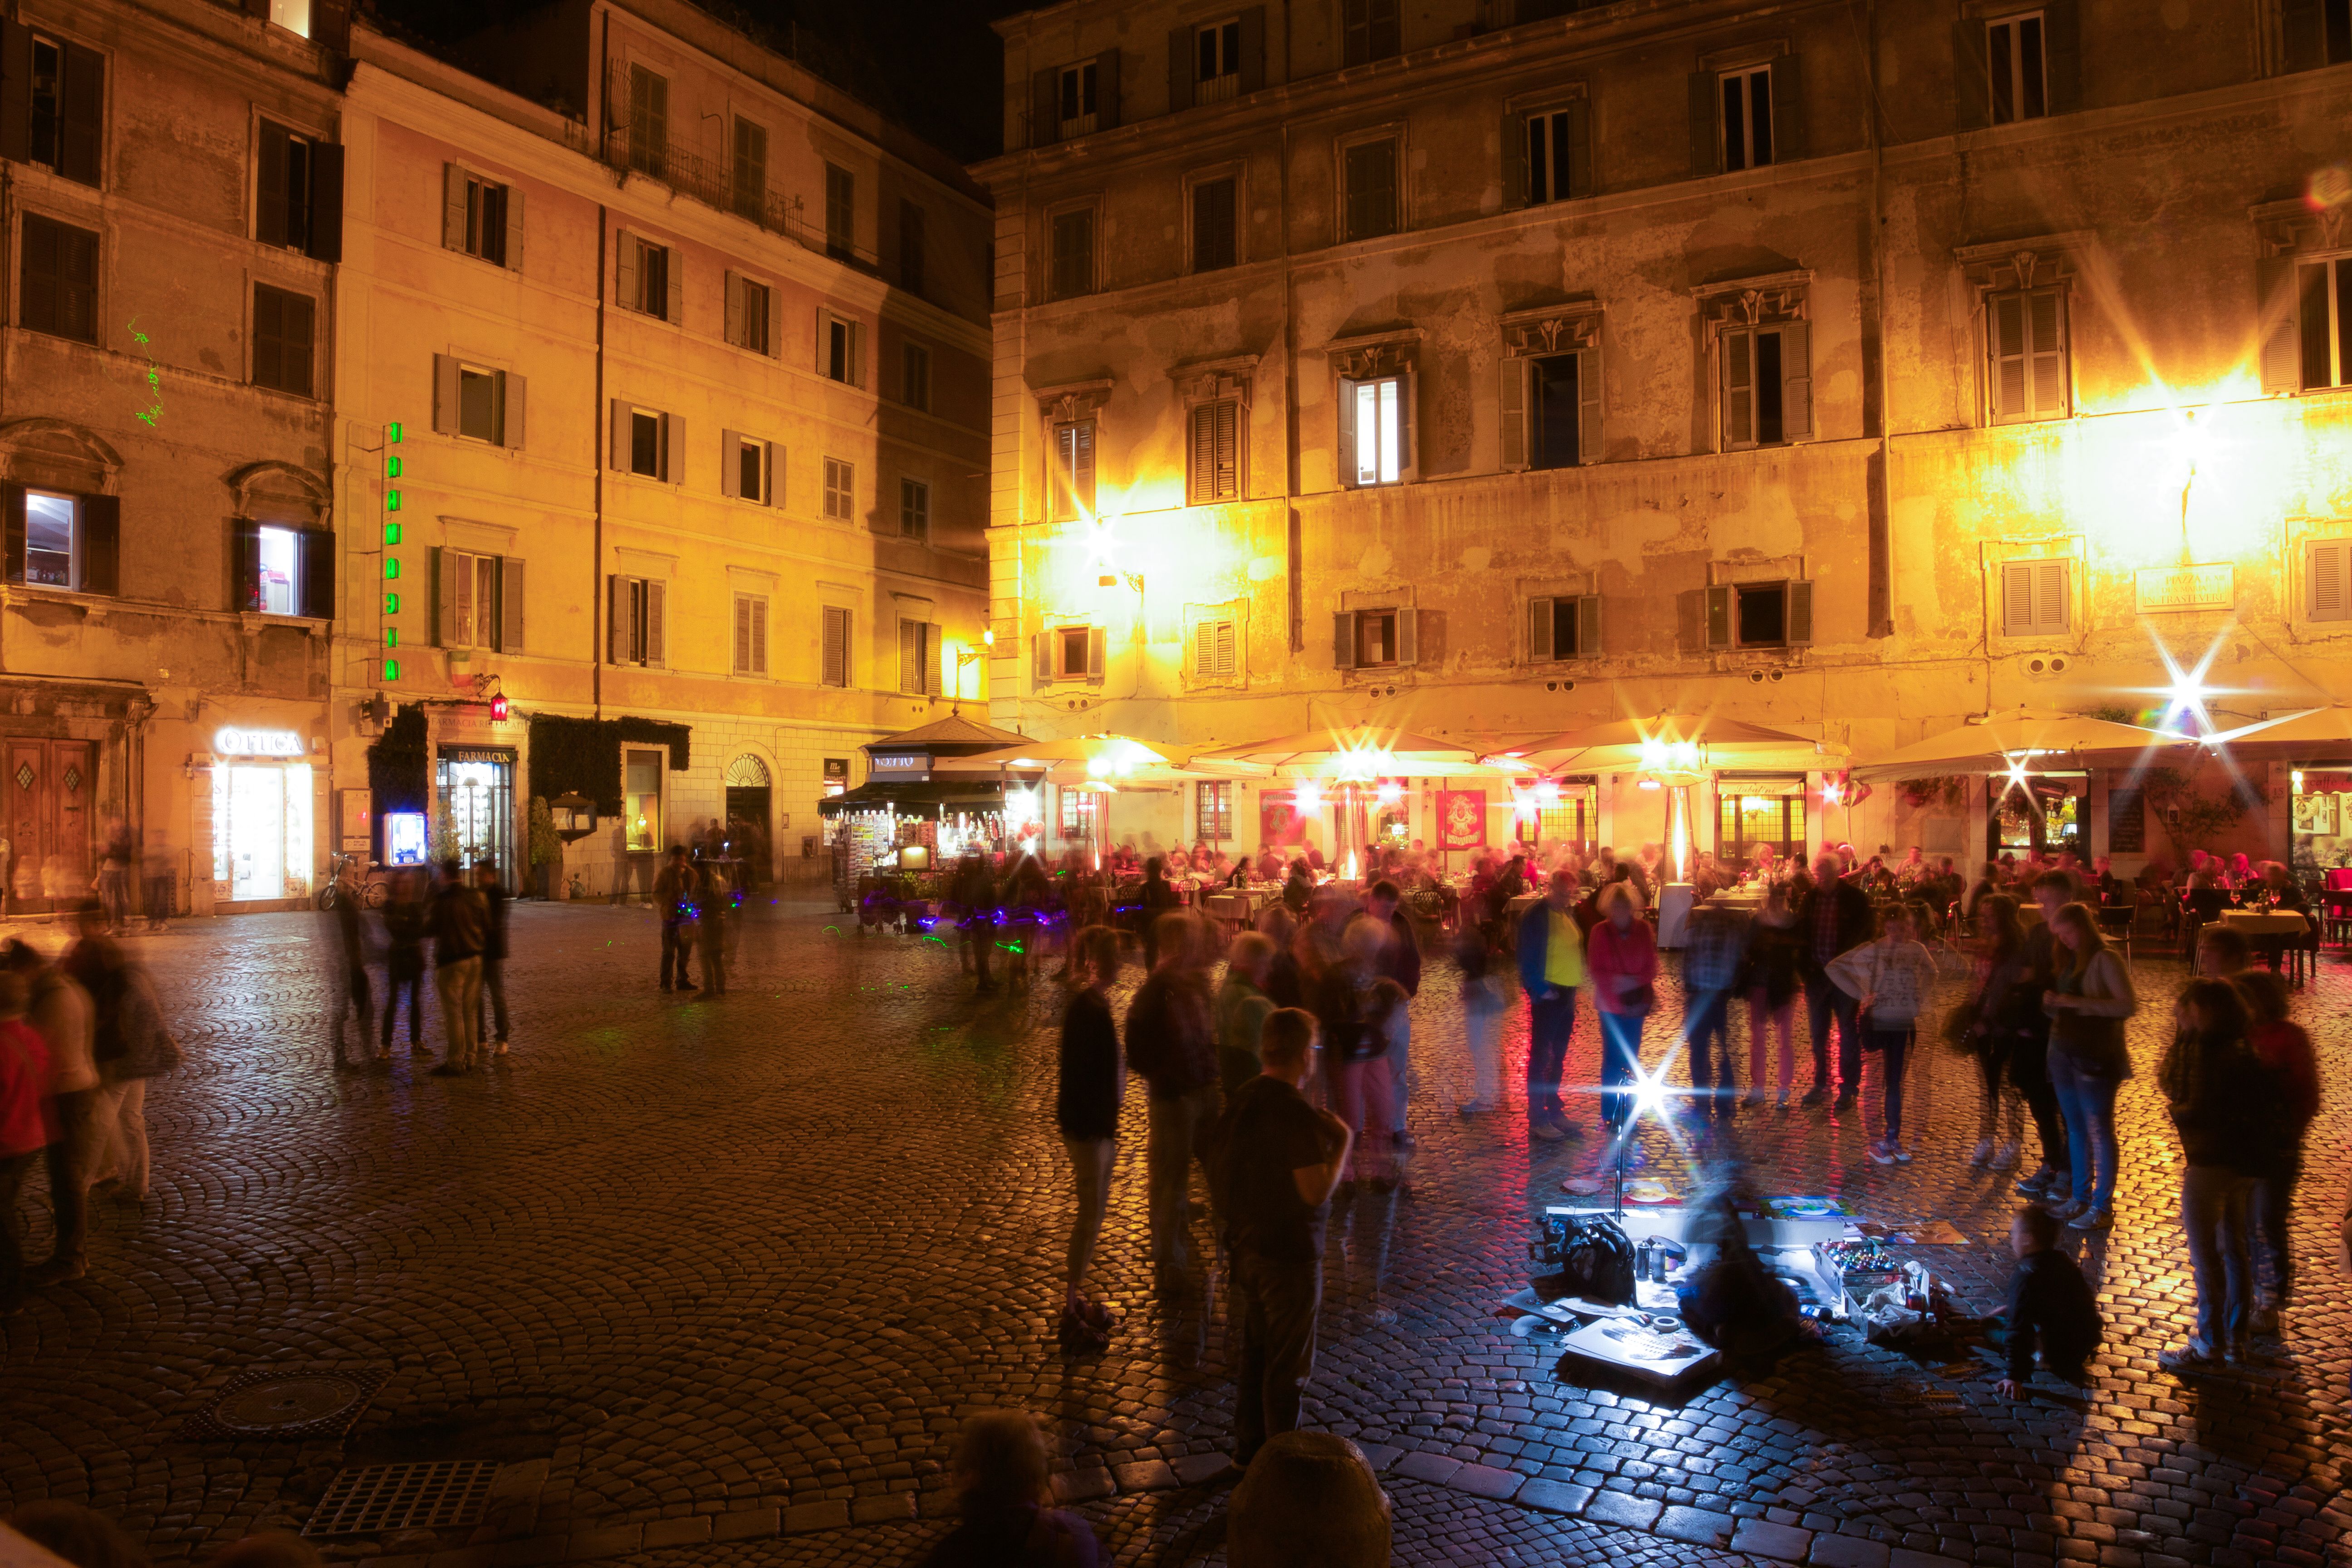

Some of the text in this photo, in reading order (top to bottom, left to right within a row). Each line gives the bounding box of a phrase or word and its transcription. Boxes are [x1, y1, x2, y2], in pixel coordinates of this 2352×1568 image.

[2166, 575, 2201, 584] PIAZZA
[2161, 593, 2223, 604] TRASTEVERE
[431, 718, 476, 727] FARMACIA
[458, 751, 510, 763] FARMACIA
[1735, 785, 1776, 793] Sabatini
